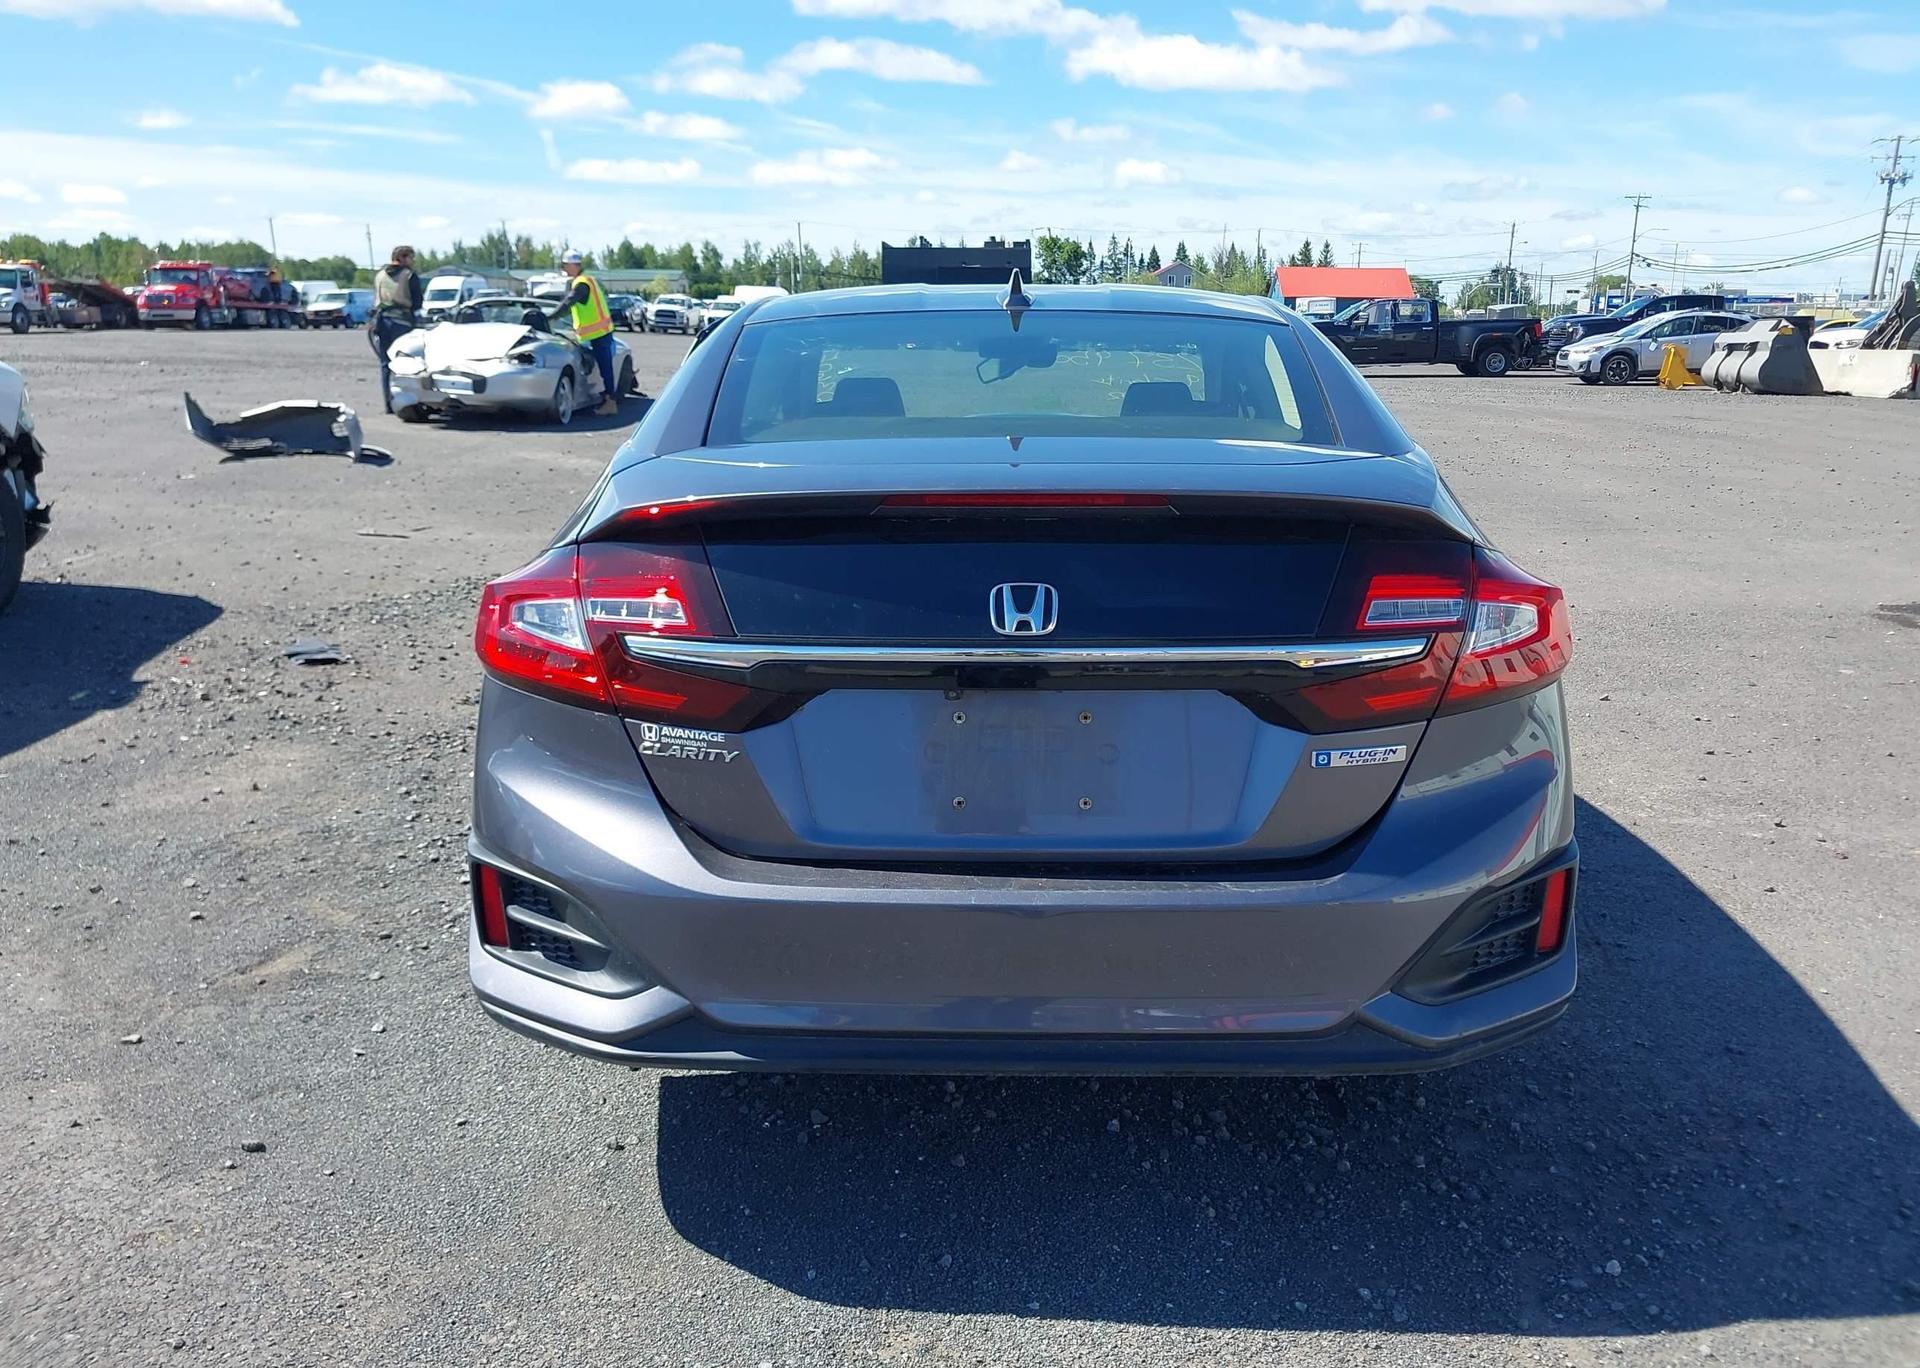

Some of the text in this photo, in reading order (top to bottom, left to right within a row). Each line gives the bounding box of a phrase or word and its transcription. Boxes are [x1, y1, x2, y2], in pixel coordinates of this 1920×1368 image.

[661, 726, 725, 742] AVANTAGE
[660, 736, 708, 748] SHAWINIGAN
[638, 741, 740, 762] CLARITY
[1339, 747, 1398, 759] PLUG-IN
[1345, 756, 1389, 765] HYBRID
